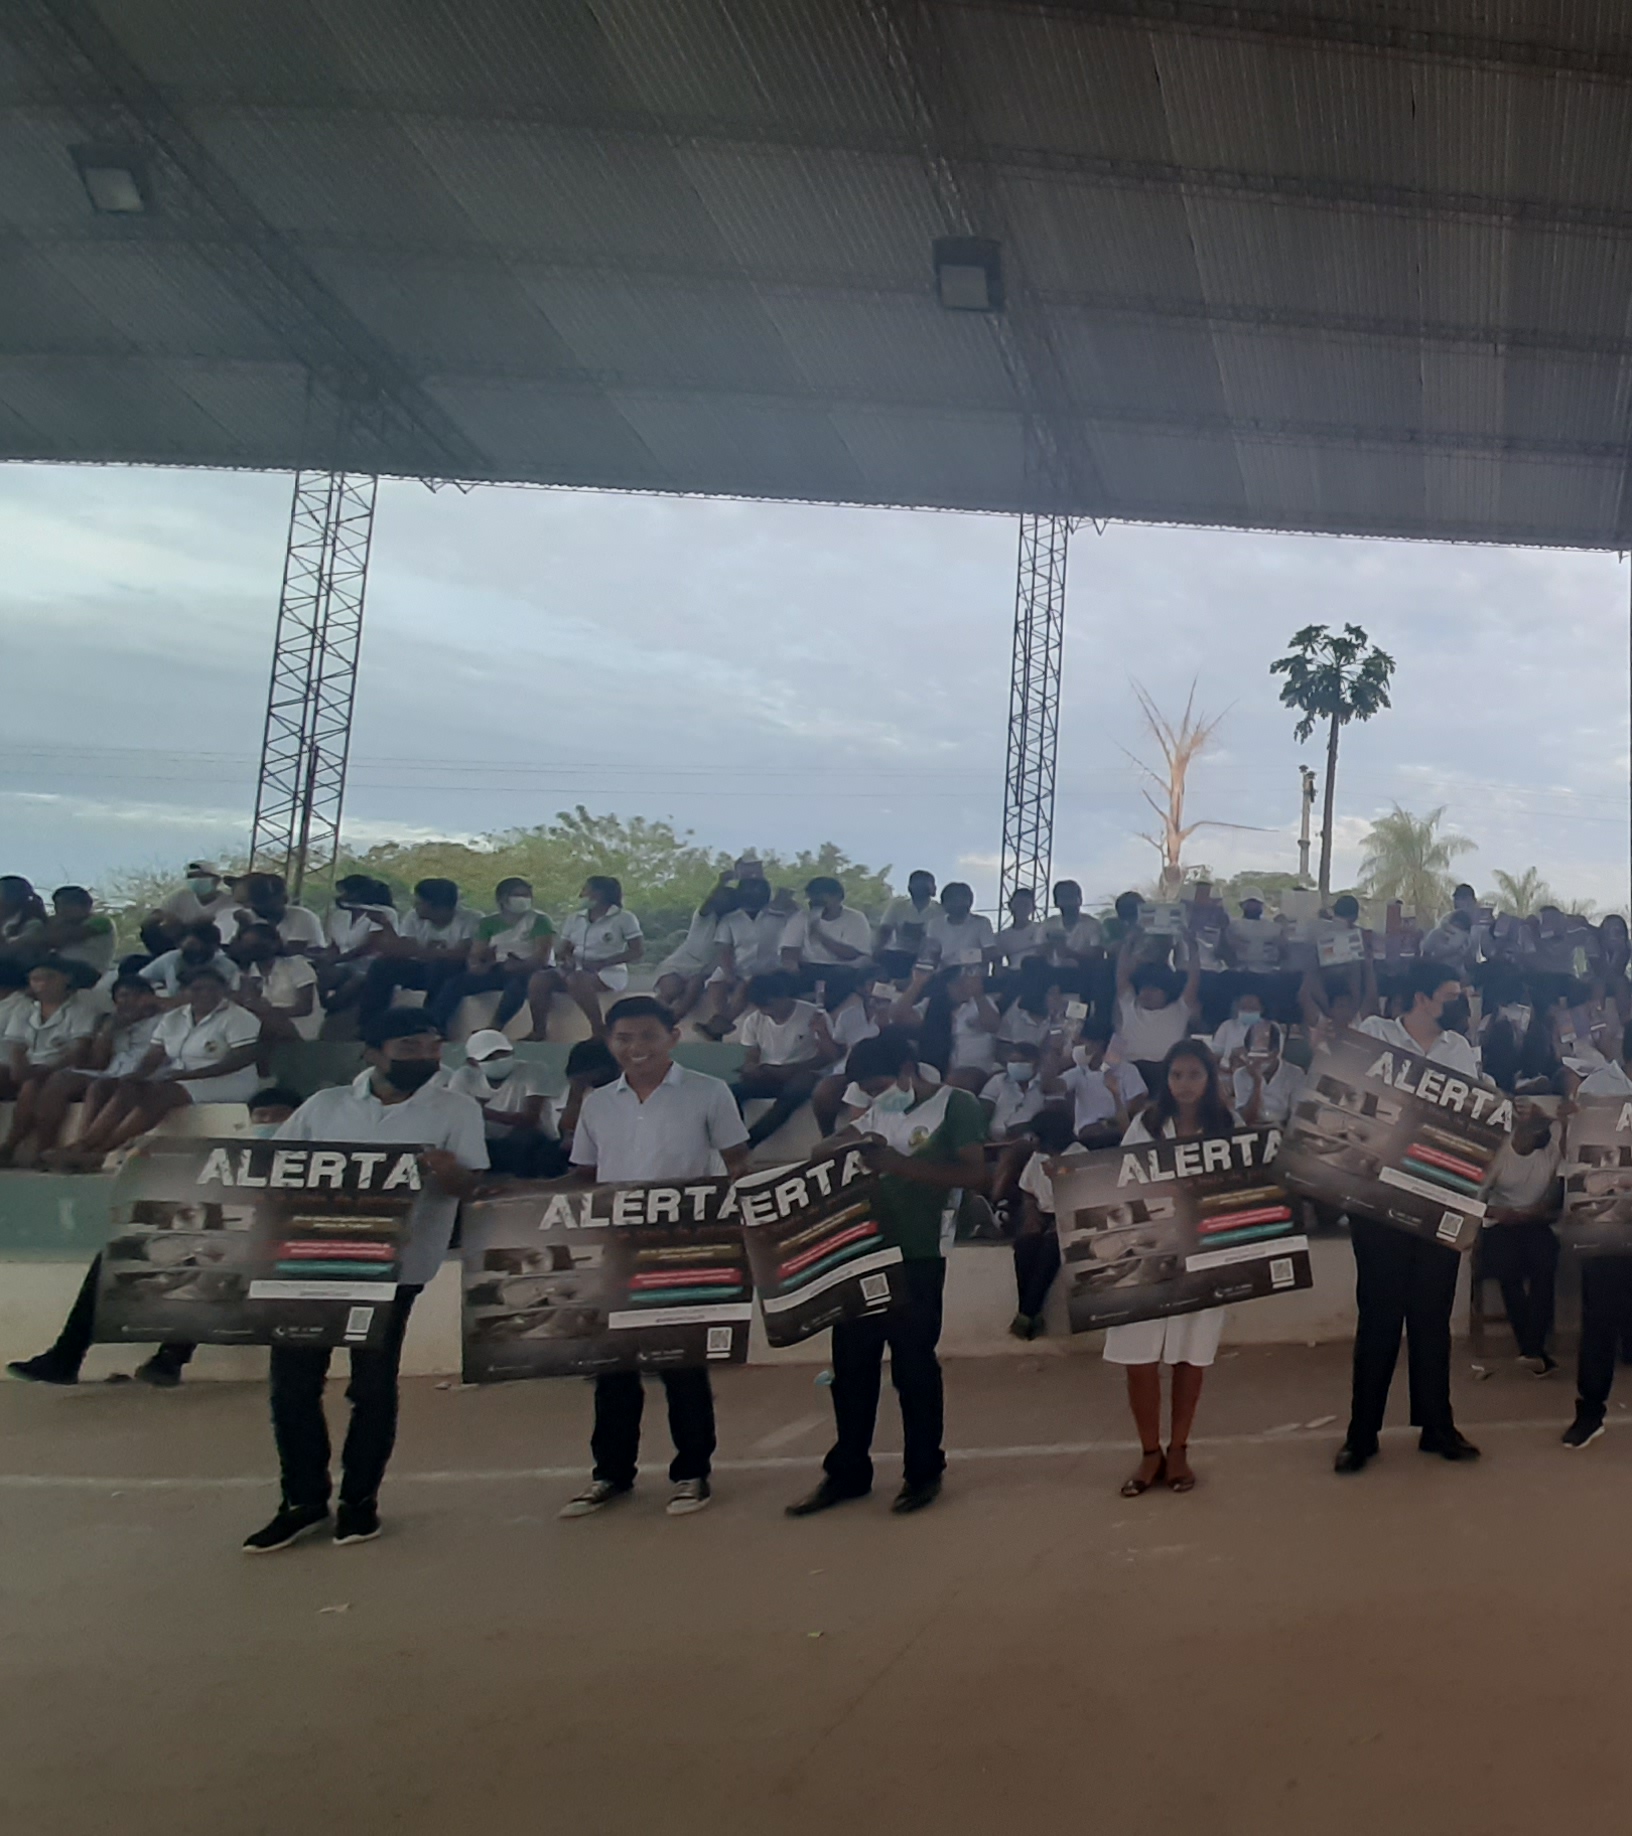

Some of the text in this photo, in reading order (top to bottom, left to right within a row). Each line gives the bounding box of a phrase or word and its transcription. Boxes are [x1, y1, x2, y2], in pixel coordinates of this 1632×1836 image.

[1365, 1051, 1515, 1132] ALERTA
[197, 1148, 422, 1192] ALERTA
[740, 1151, 872, 1227] ERTA
